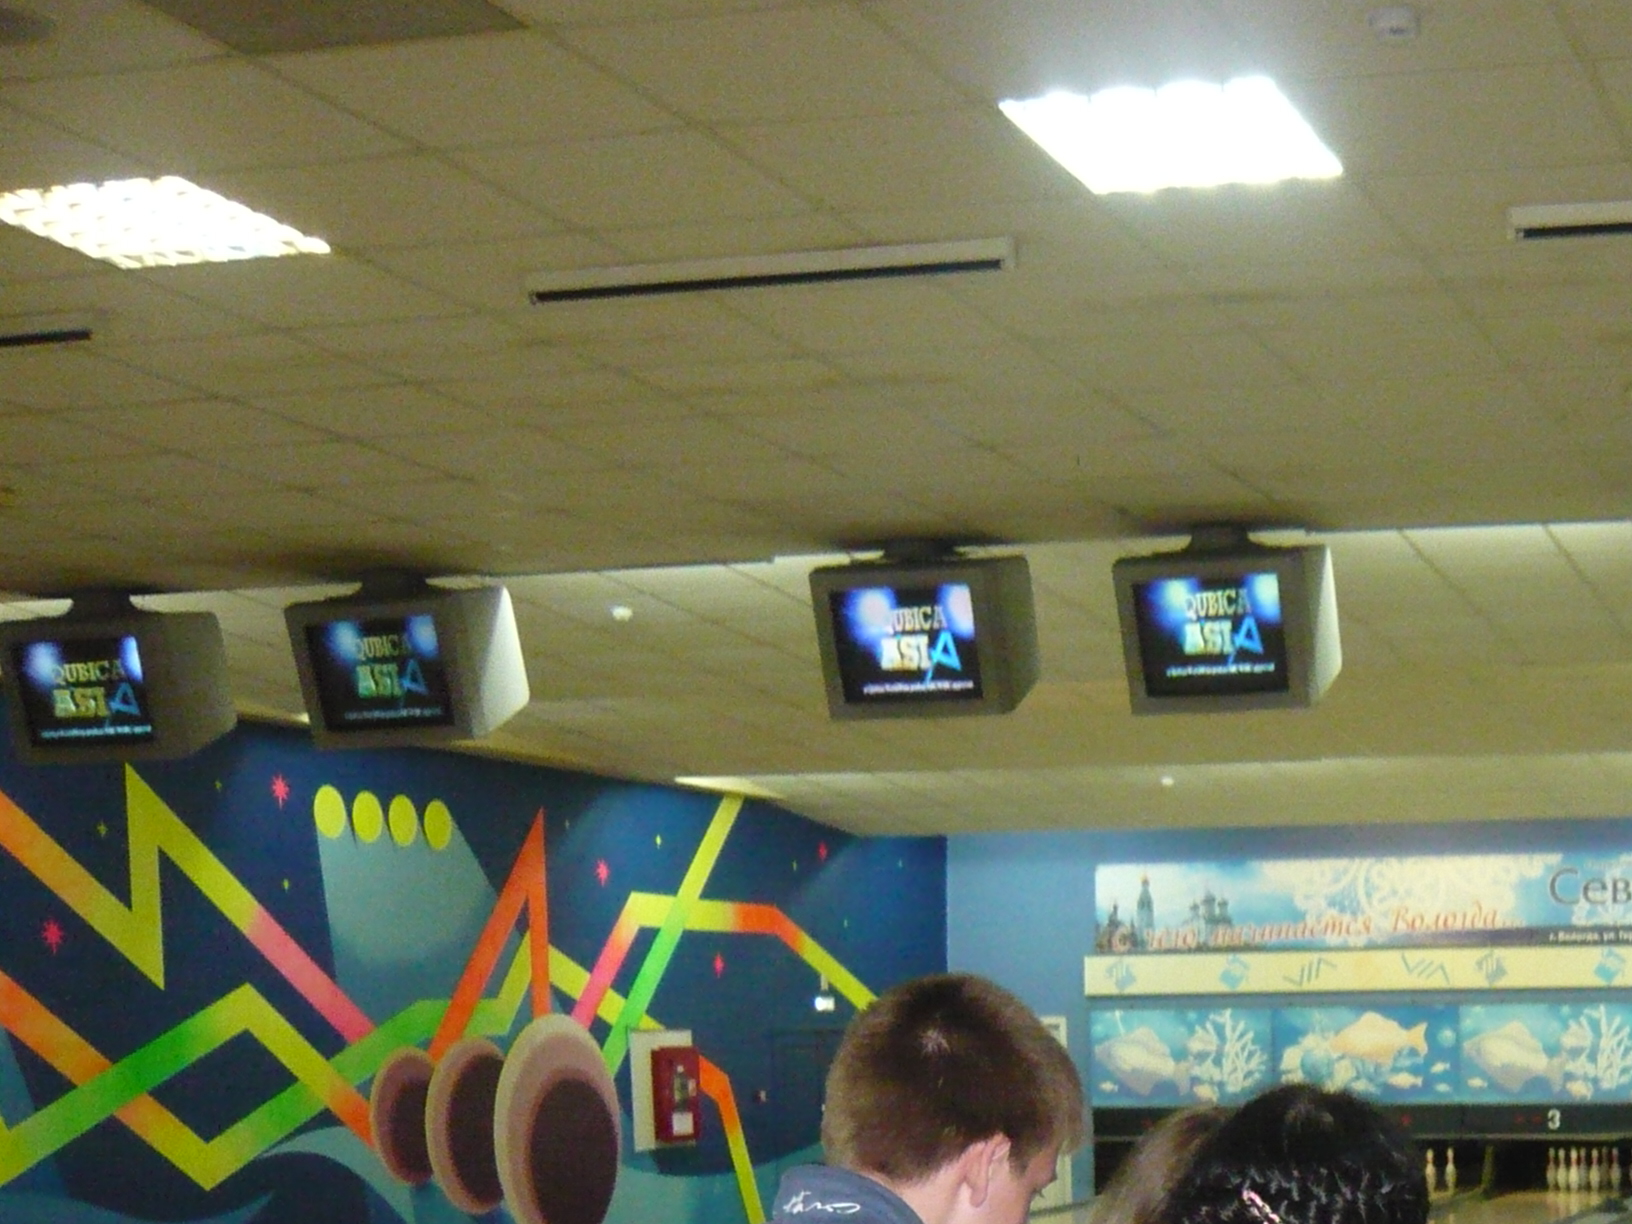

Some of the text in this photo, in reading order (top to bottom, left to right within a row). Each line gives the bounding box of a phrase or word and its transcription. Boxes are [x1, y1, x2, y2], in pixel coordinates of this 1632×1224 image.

[1184, 588, 1251, 621] QUBICA
[52, 659, 126, 685] QUBICA
[1548, 1108, 1561, 1131] 3
